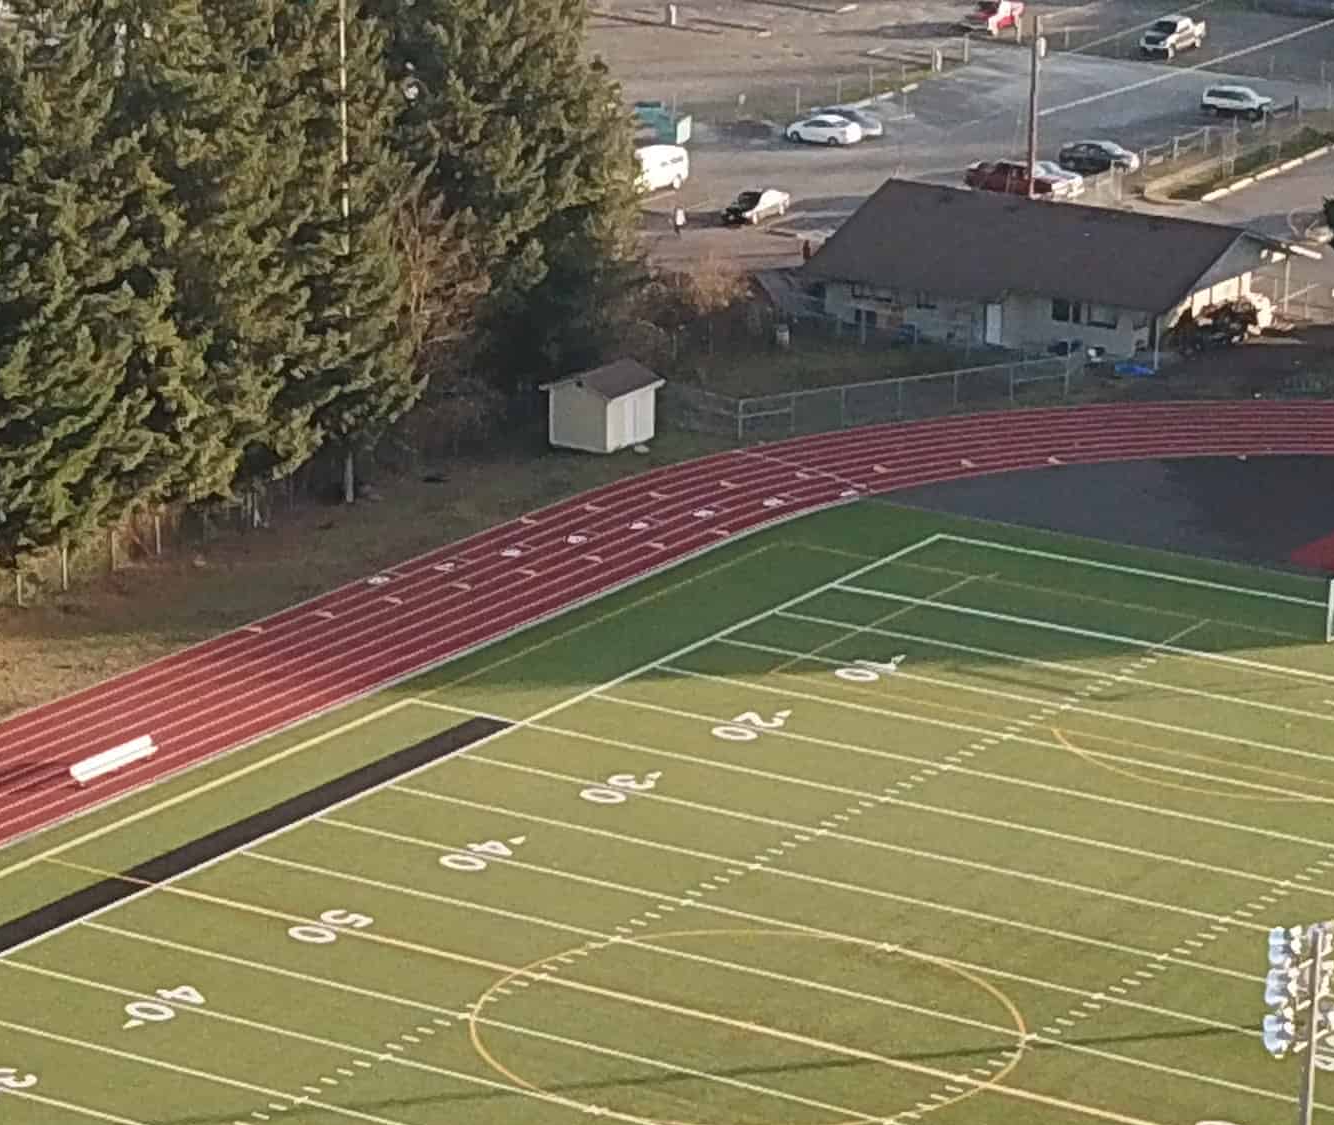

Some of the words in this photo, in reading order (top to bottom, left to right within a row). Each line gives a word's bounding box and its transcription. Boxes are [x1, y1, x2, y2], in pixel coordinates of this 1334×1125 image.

[834, 659, 900, 682] 10
[711, 711, 781, 741] 20
[579, 774, 653, 804] 30
[438, 840, 514, 872] 40
[288, 909, 373, 944] 50
[124, 984, 206, 1022] 40
